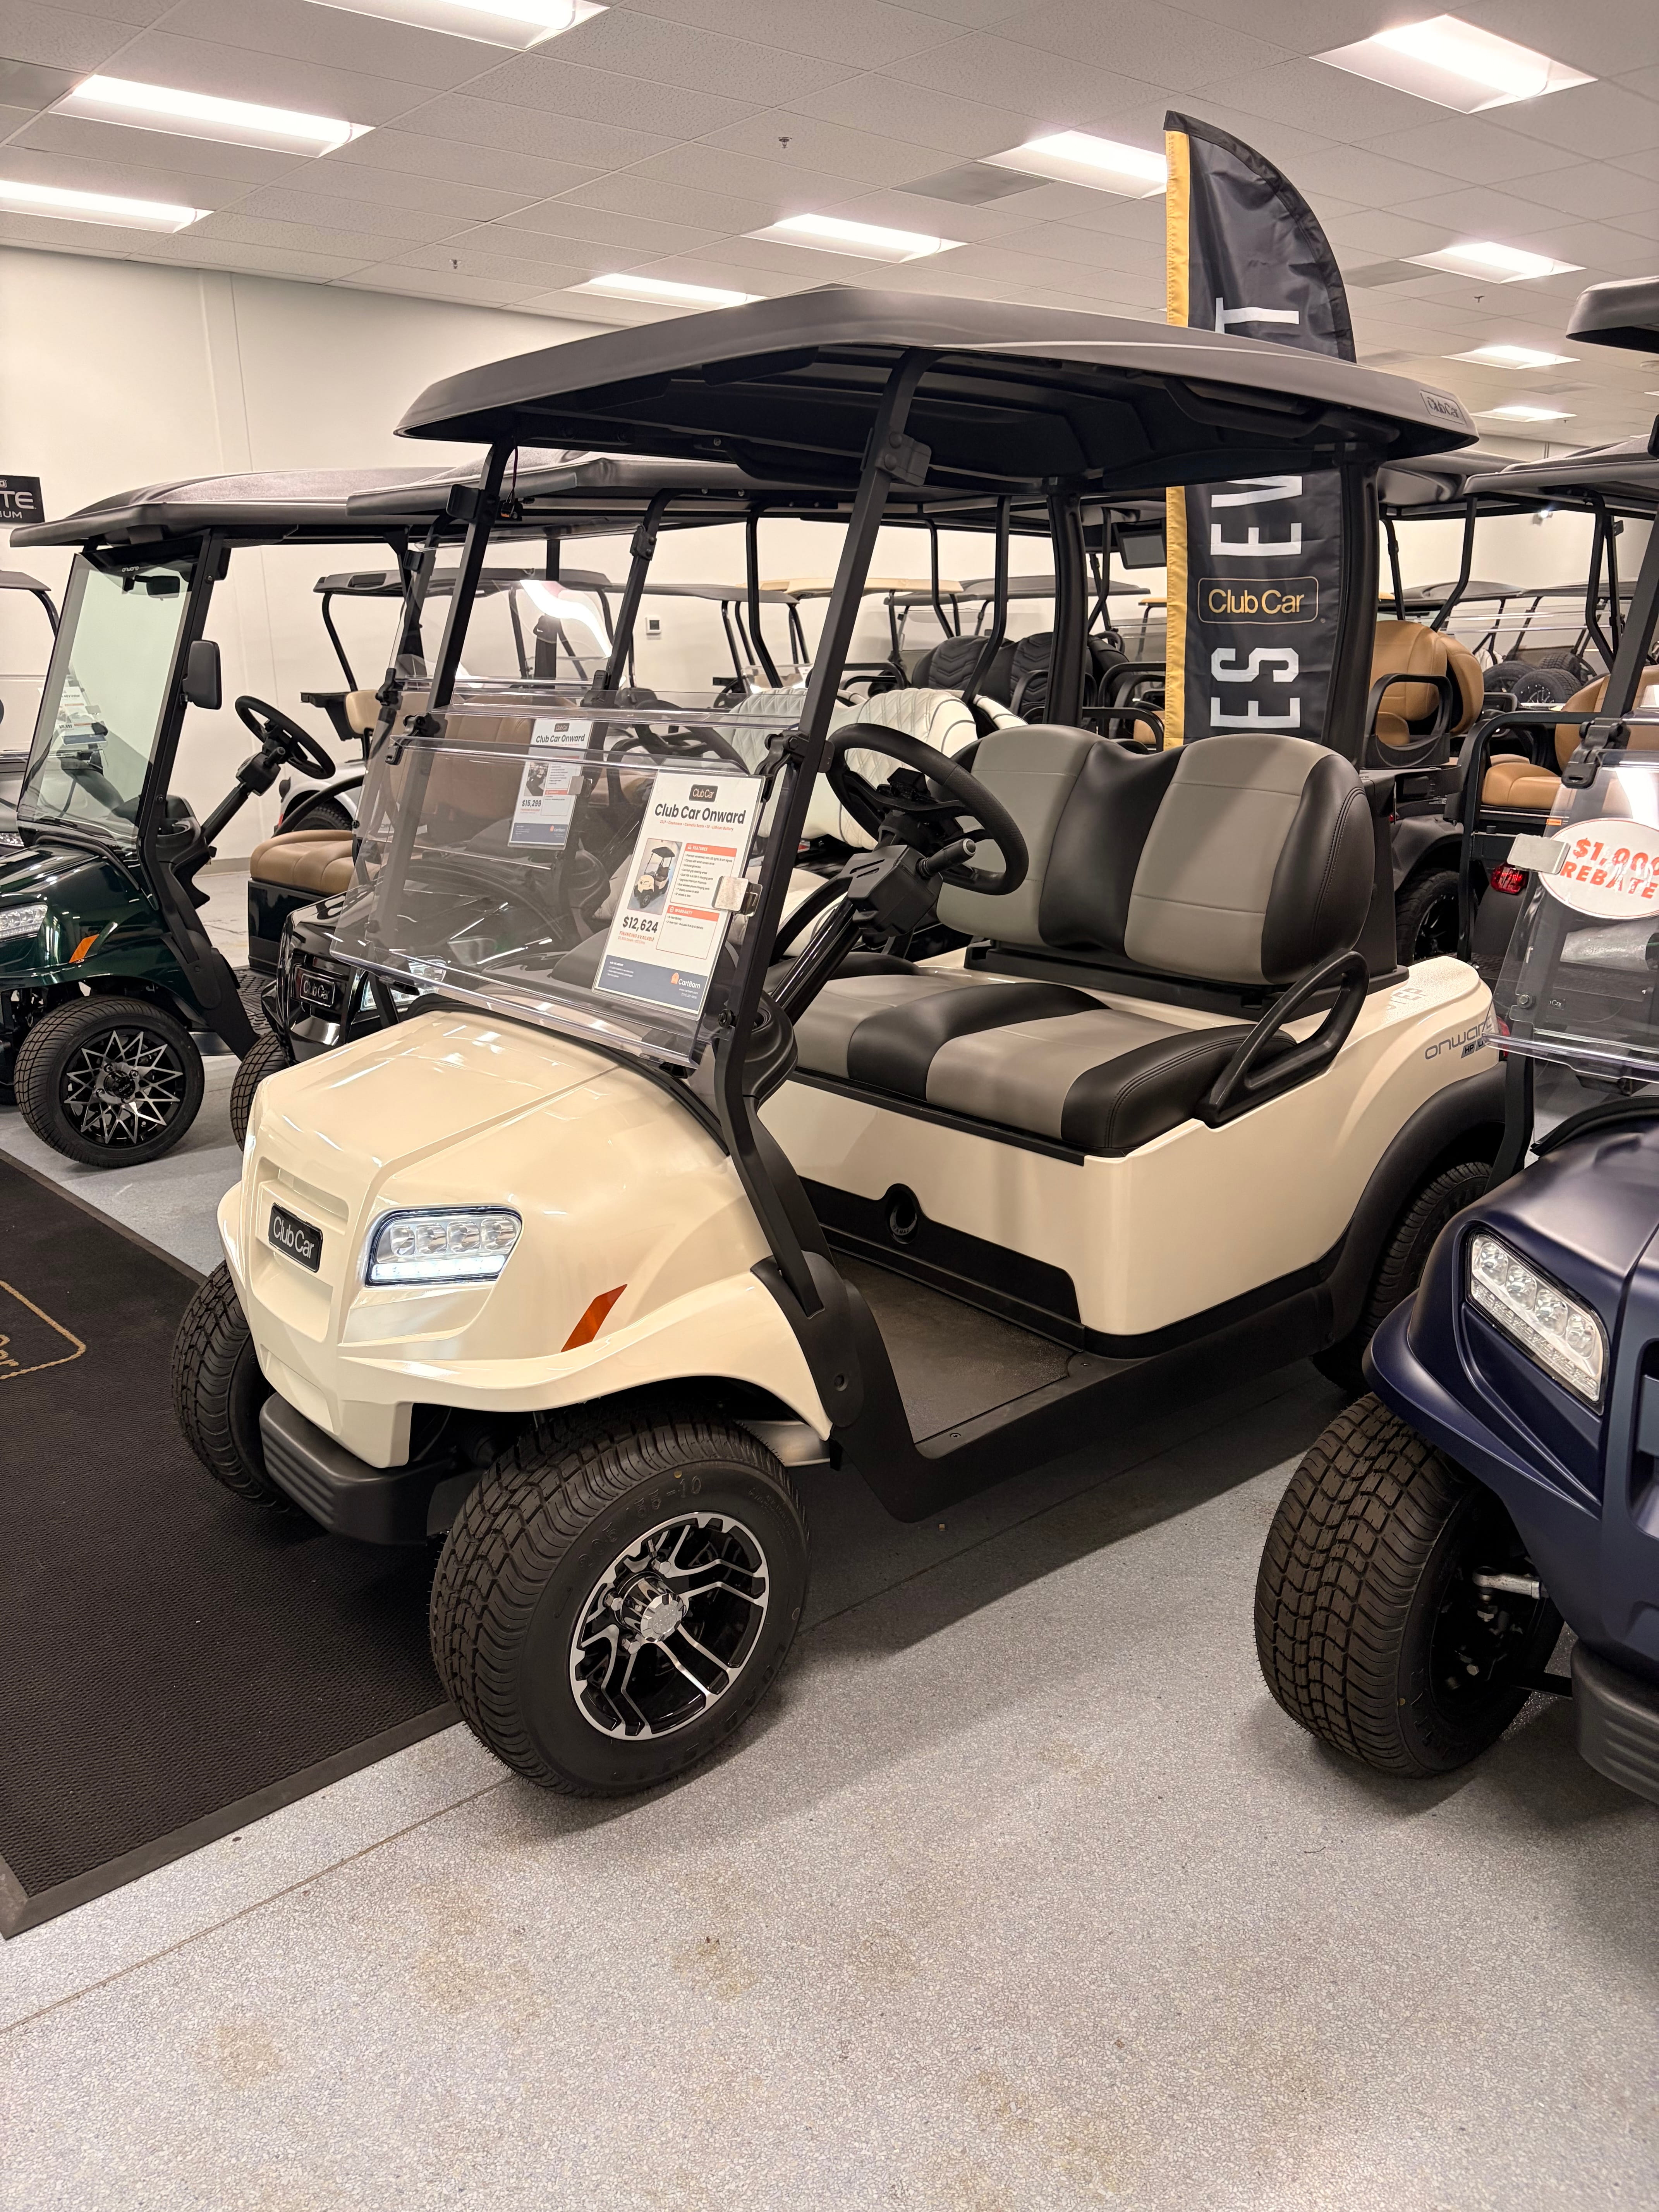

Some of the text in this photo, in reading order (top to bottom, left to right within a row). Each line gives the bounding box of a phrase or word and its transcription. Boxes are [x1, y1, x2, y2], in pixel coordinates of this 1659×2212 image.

[1427, 397, 1459, 418] Club Car
[0, 491, 34, 509] TE
[0, 510, 22, 519] IUM
[1208, 589, 1305, 614] Club Car
[1210, 647, 1300, 728] ES
[536, 735, 549, 743] Club
[562, 734, 586, 742] Onward
[693, 788, 714, 799] Club Car
[522, 799, 541, 807] $15,299
[655, 803, 746, 824] Club Car Onward
[1560, 861, 1659, 899] REBATE
[622, 915, 658, 933] $12,624
[678, 979, 700, 989] CartBarn
[1465, 1045, 1474, 1054] HP
[273, 1216, 314, 1259] Club Car
